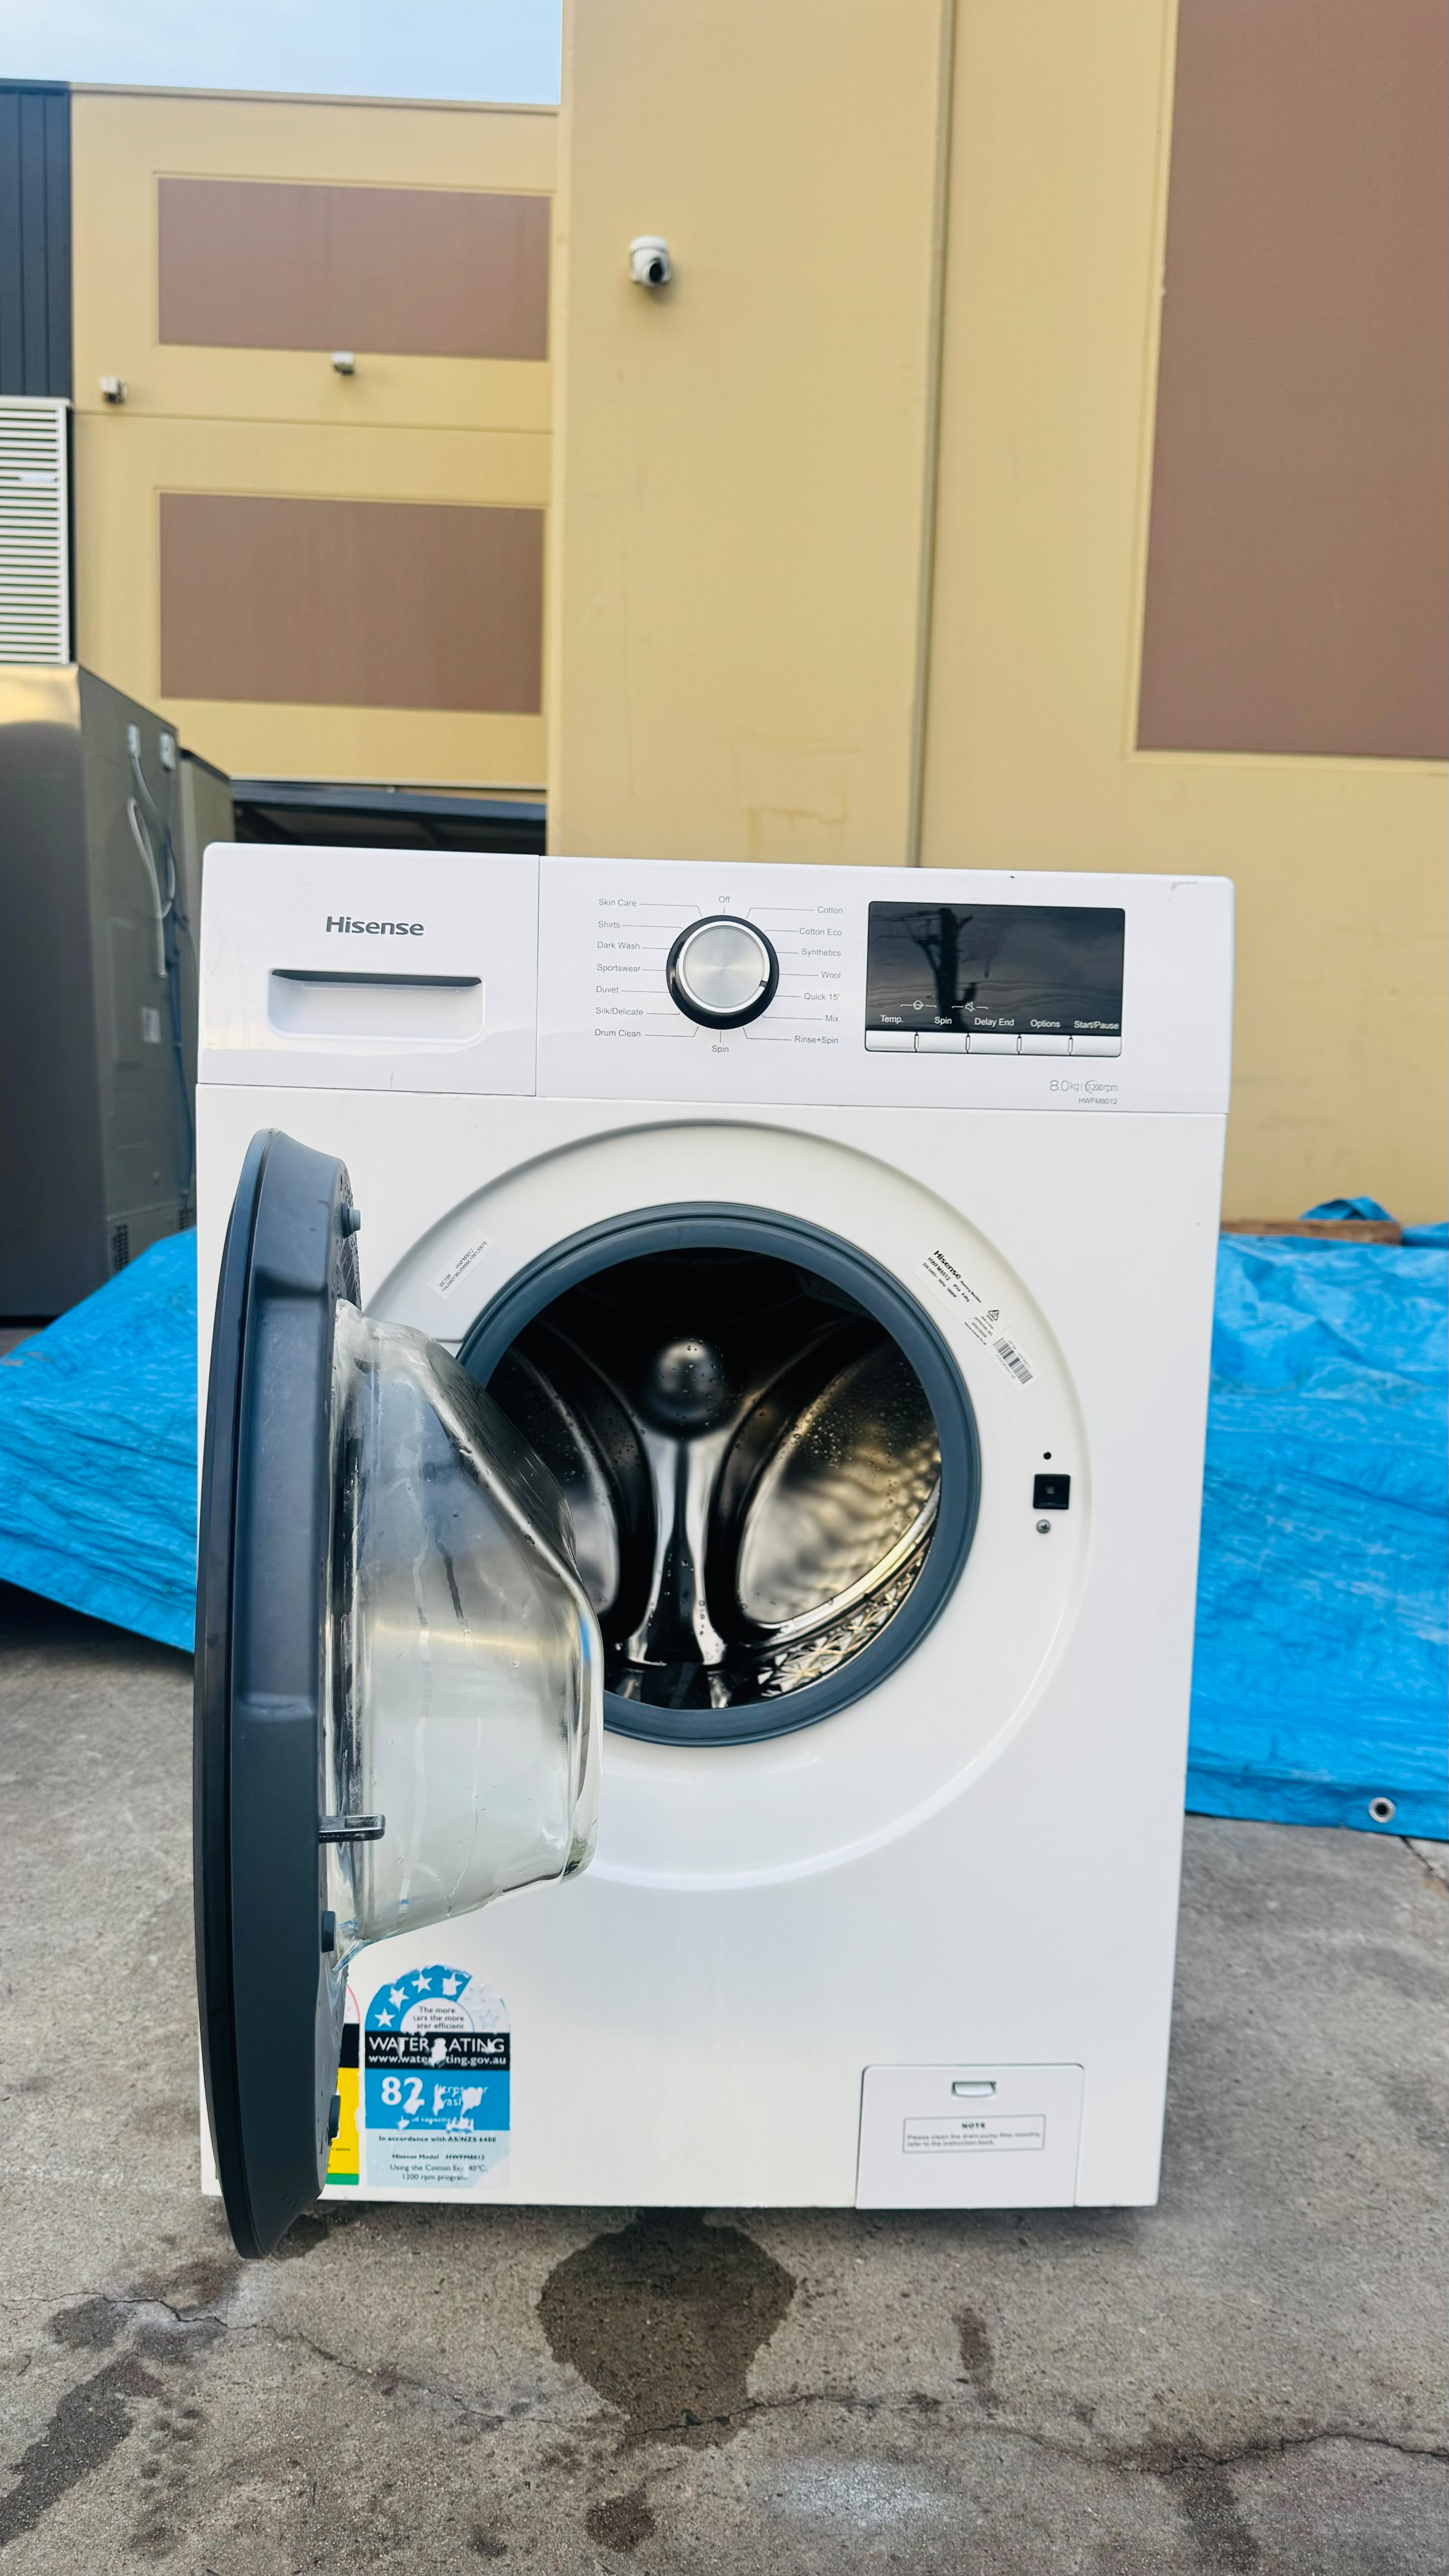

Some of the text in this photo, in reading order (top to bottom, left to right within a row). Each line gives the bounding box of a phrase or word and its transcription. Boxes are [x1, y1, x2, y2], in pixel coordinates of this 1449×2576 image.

[326, 916, 424, 936] Hisense
[801, 948, 841, 957] Synthetics
[597, 964, 641, 973] Sportswear
[804, 993, 826, 1001] Quick
[596, 1008, 643, 1016] Silk/Delicate
[880, 1014, 904, 1024] Temp.
[934, 1016, 952, 1025] Spin
[975, 1018, 1014, 1027] Delay End
[1030, 1019, 1061, 1028] Options
[1074, 1020, 1119, 1029] Start/Pause
[794, 1036, 839, 1045] Rinse+Spin
[711, 1045, 729, 1054] Spin
[927, 1257, 950, 1281] HWFM8012
[934, 1250, 961, 1279] Hisense
[369, 2037, 504, 2053] WATER ATING
[369, 2055, 506, 2066] www.wateting.gov.au
[381, 2076, 425, 2108] 82
